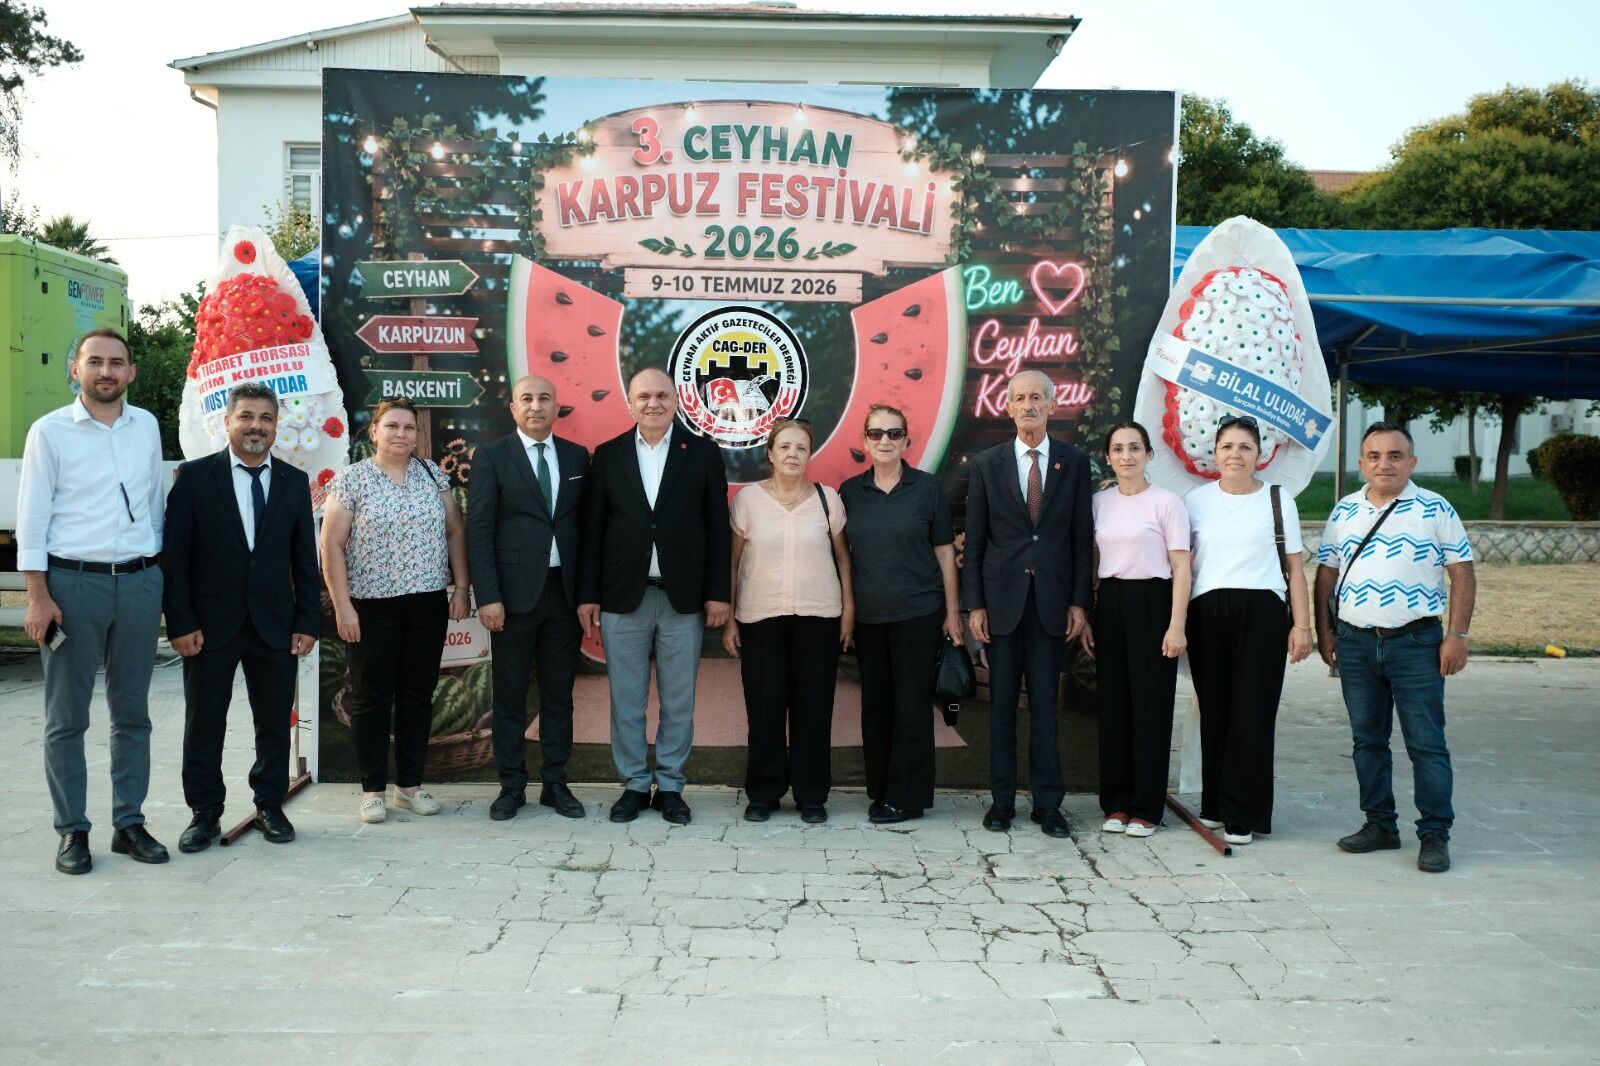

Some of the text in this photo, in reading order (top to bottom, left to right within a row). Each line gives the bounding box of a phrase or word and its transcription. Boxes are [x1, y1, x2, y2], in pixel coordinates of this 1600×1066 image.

[631, 117, 853, 168] 3. CEYHAN
[558, 169, 937, 235] KARPUZ FESTİVALİ
[704, 225, 800, 261] 2026
[68, 279, 105, 305] GENPOWER
[383, 270, 450, 288] CEYHAN
[651, 275, 837, 295] 9-10 TEMMUZ 2026
[963, 265, 1024, 309] Ben
[378, 325, 465, 344] KARPUZUN
[712, 340, 767, 354] CAG-DER
[974, 317, 1079, 377] Ceyhan
[250, 345, 311, 364] BORSASI
[682, 318, 797, 385] CEYHAN AKTİF GAZETECİLER DERNEĞİ
[199, 361, 304, 394] ETİM KURULU
[382, 378, 461, 400] BAŞKENTİ
[203, 387, 233, 415] MUST
[975, 374, 1092, 418] Kazu
[1216, 371, 1307, 426] BİLAL ULUDAĞ
